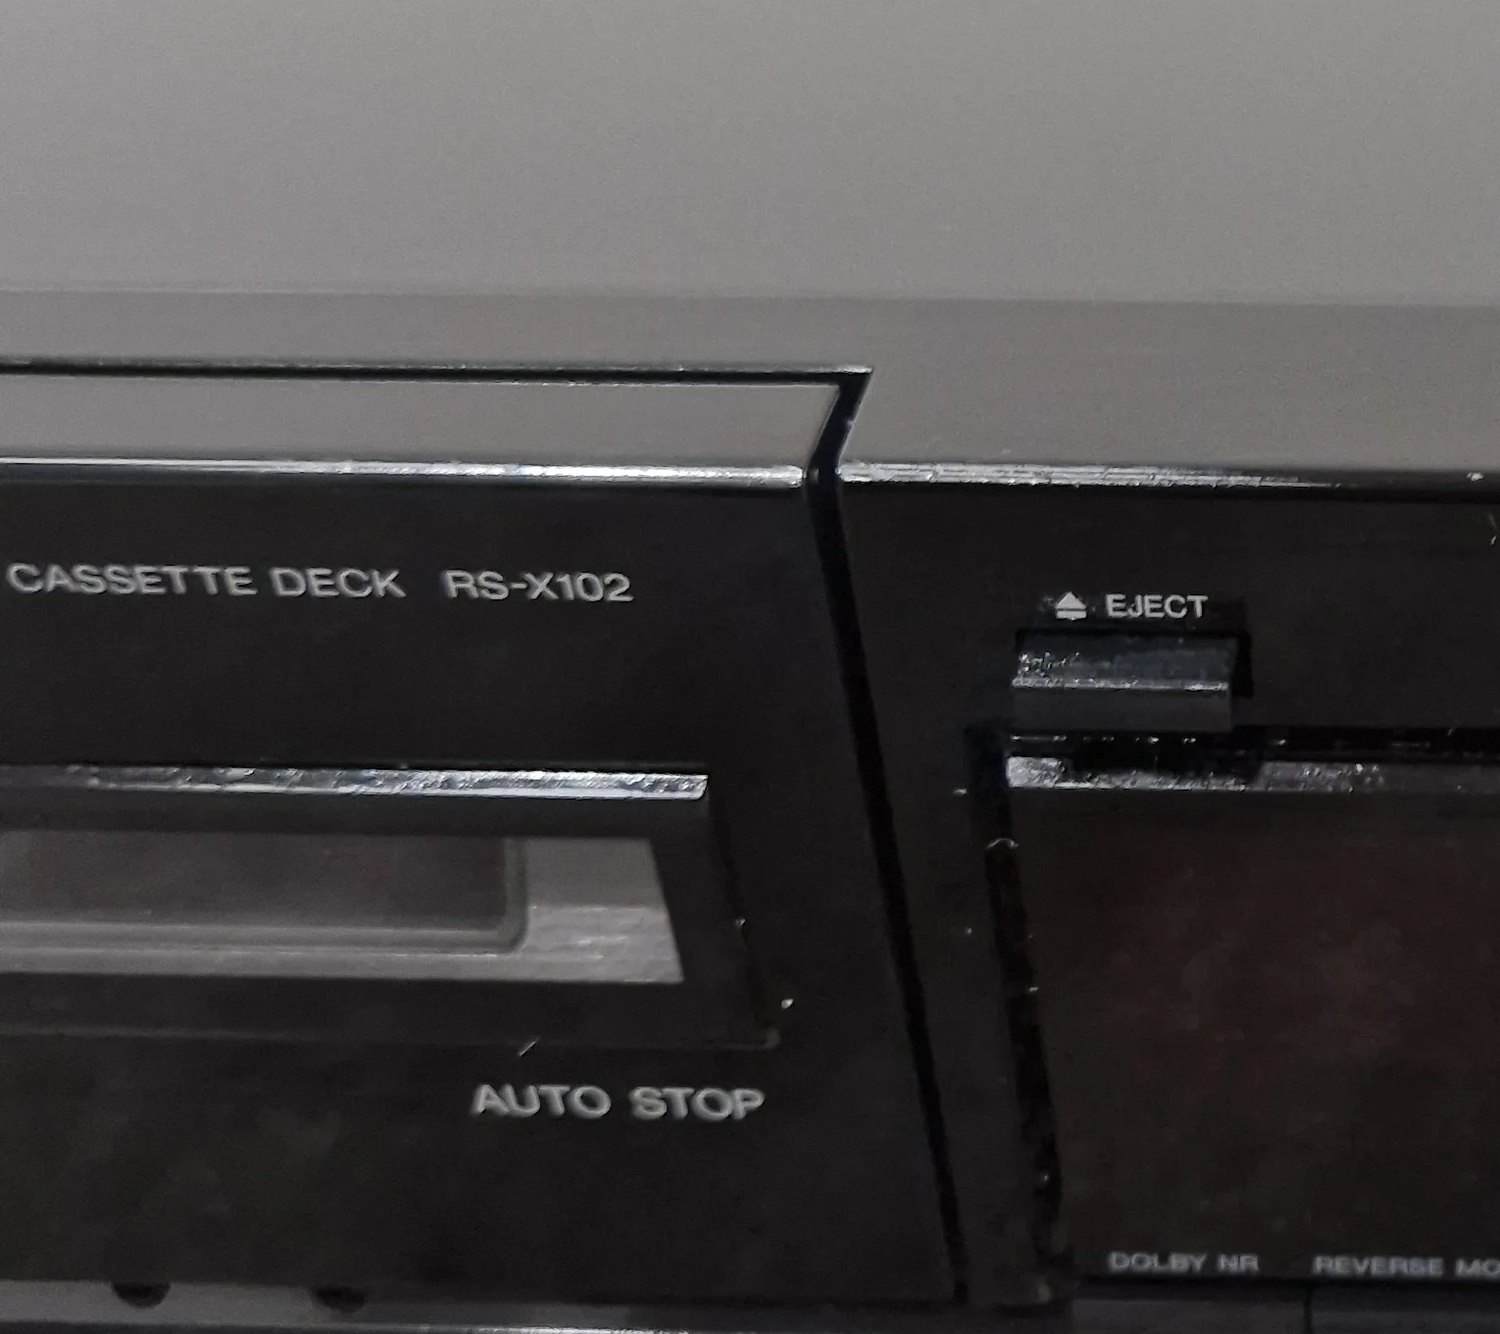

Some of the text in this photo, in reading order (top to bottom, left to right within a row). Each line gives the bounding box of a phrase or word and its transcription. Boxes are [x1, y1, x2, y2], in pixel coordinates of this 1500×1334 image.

[9, 564, 634, 602] CASSETTE DECK RS-X102
[1106, 594, 1208, 620] EJECT
[470, 1085, 766, 1120] AUTO STOP
[1108, 1251, 1259, 1273] DOLBY NR
[1313, 1256, 1443, 1278] REVERSE
